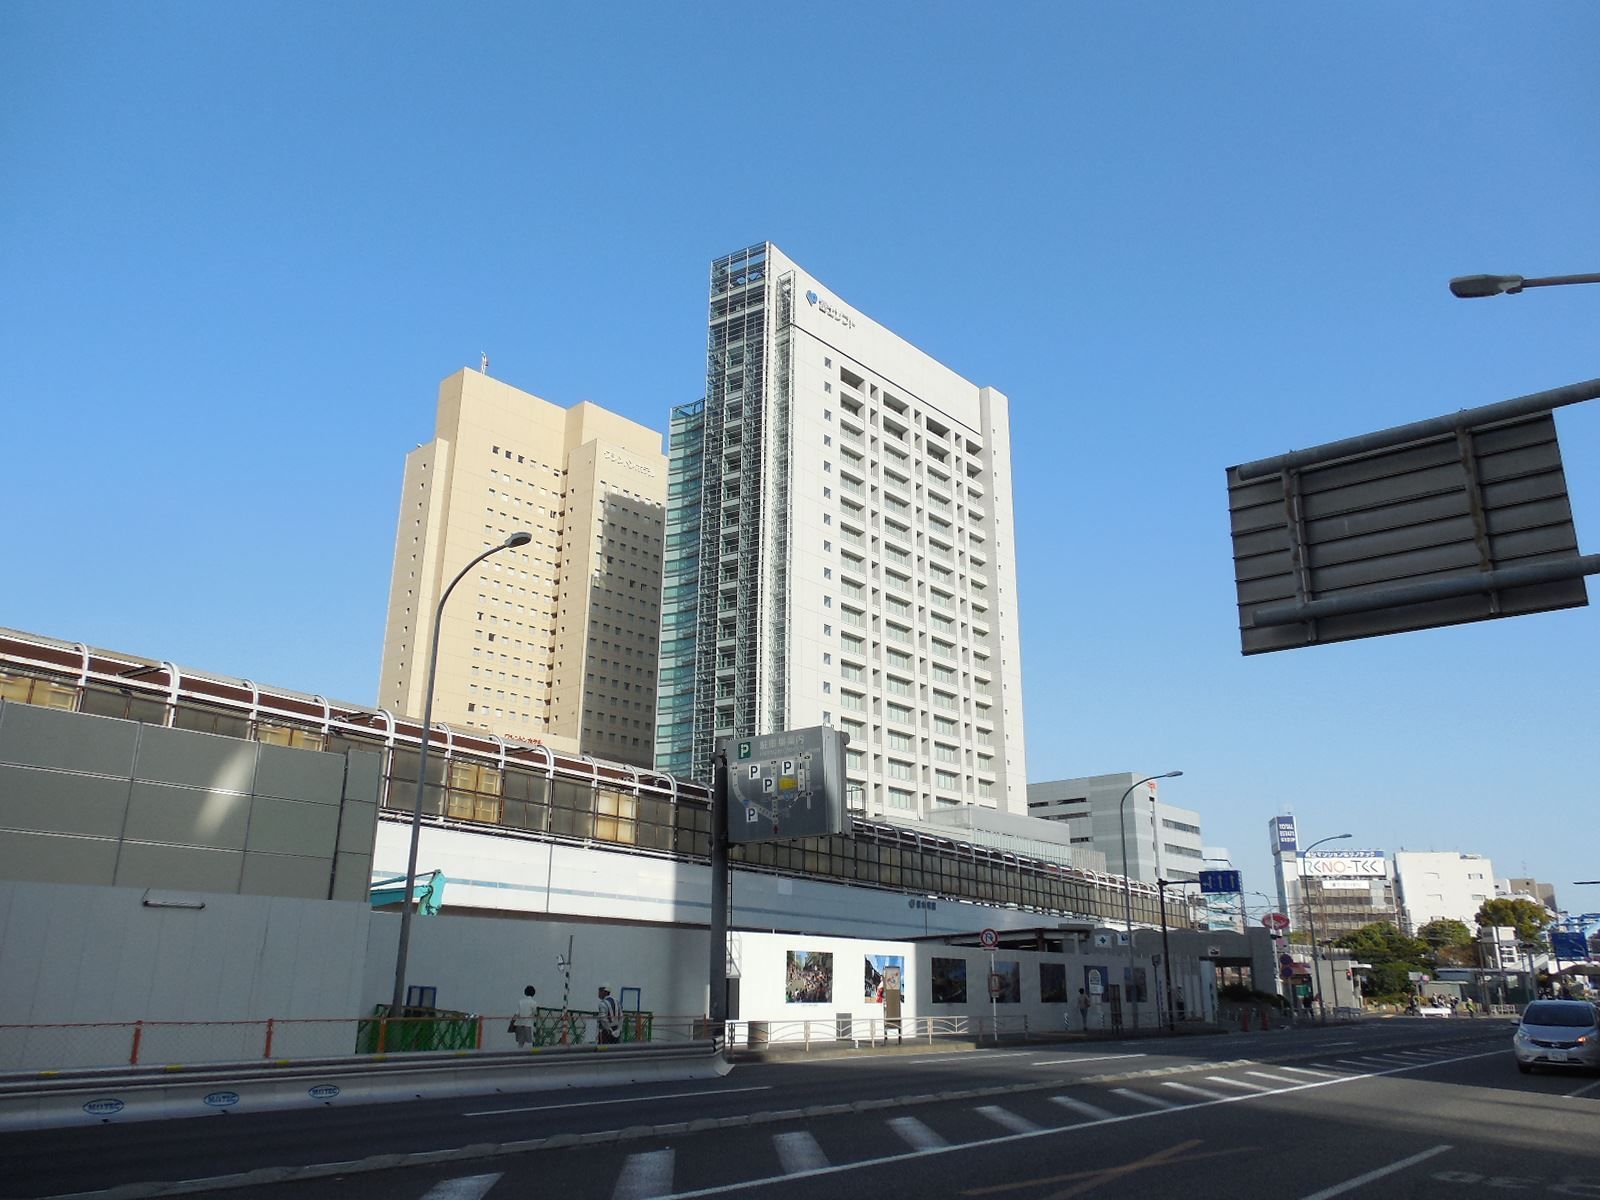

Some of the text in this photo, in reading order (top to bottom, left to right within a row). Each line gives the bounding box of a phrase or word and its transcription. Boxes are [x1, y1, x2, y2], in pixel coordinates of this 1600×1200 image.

[740, 743, 749, 758] P
[750, 765, 758, 778] P
[783, 761, 792, 774] P
[764, 778, 773, 791] P
[748, 808, 756, 820] P
